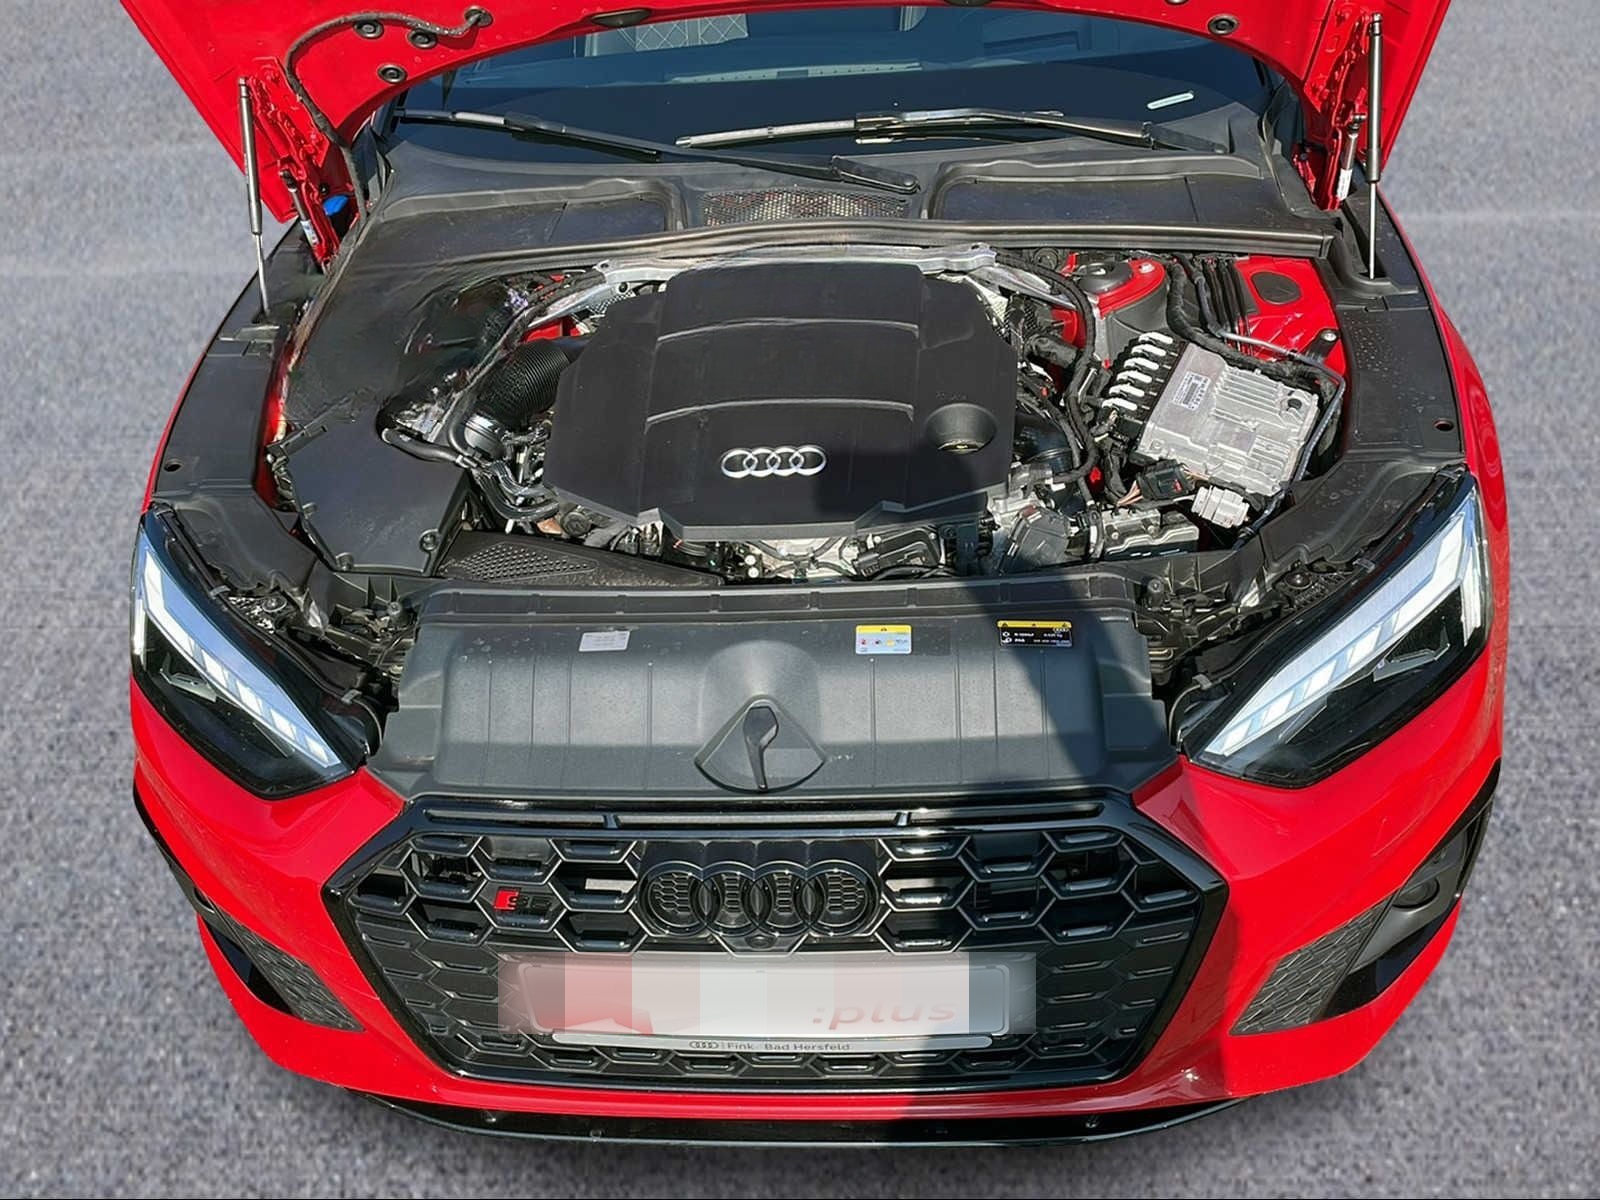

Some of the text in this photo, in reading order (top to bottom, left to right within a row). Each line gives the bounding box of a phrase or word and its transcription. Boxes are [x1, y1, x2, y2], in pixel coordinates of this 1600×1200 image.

[727, 1042, 851, 1051] Fink Bad Hersfeld
